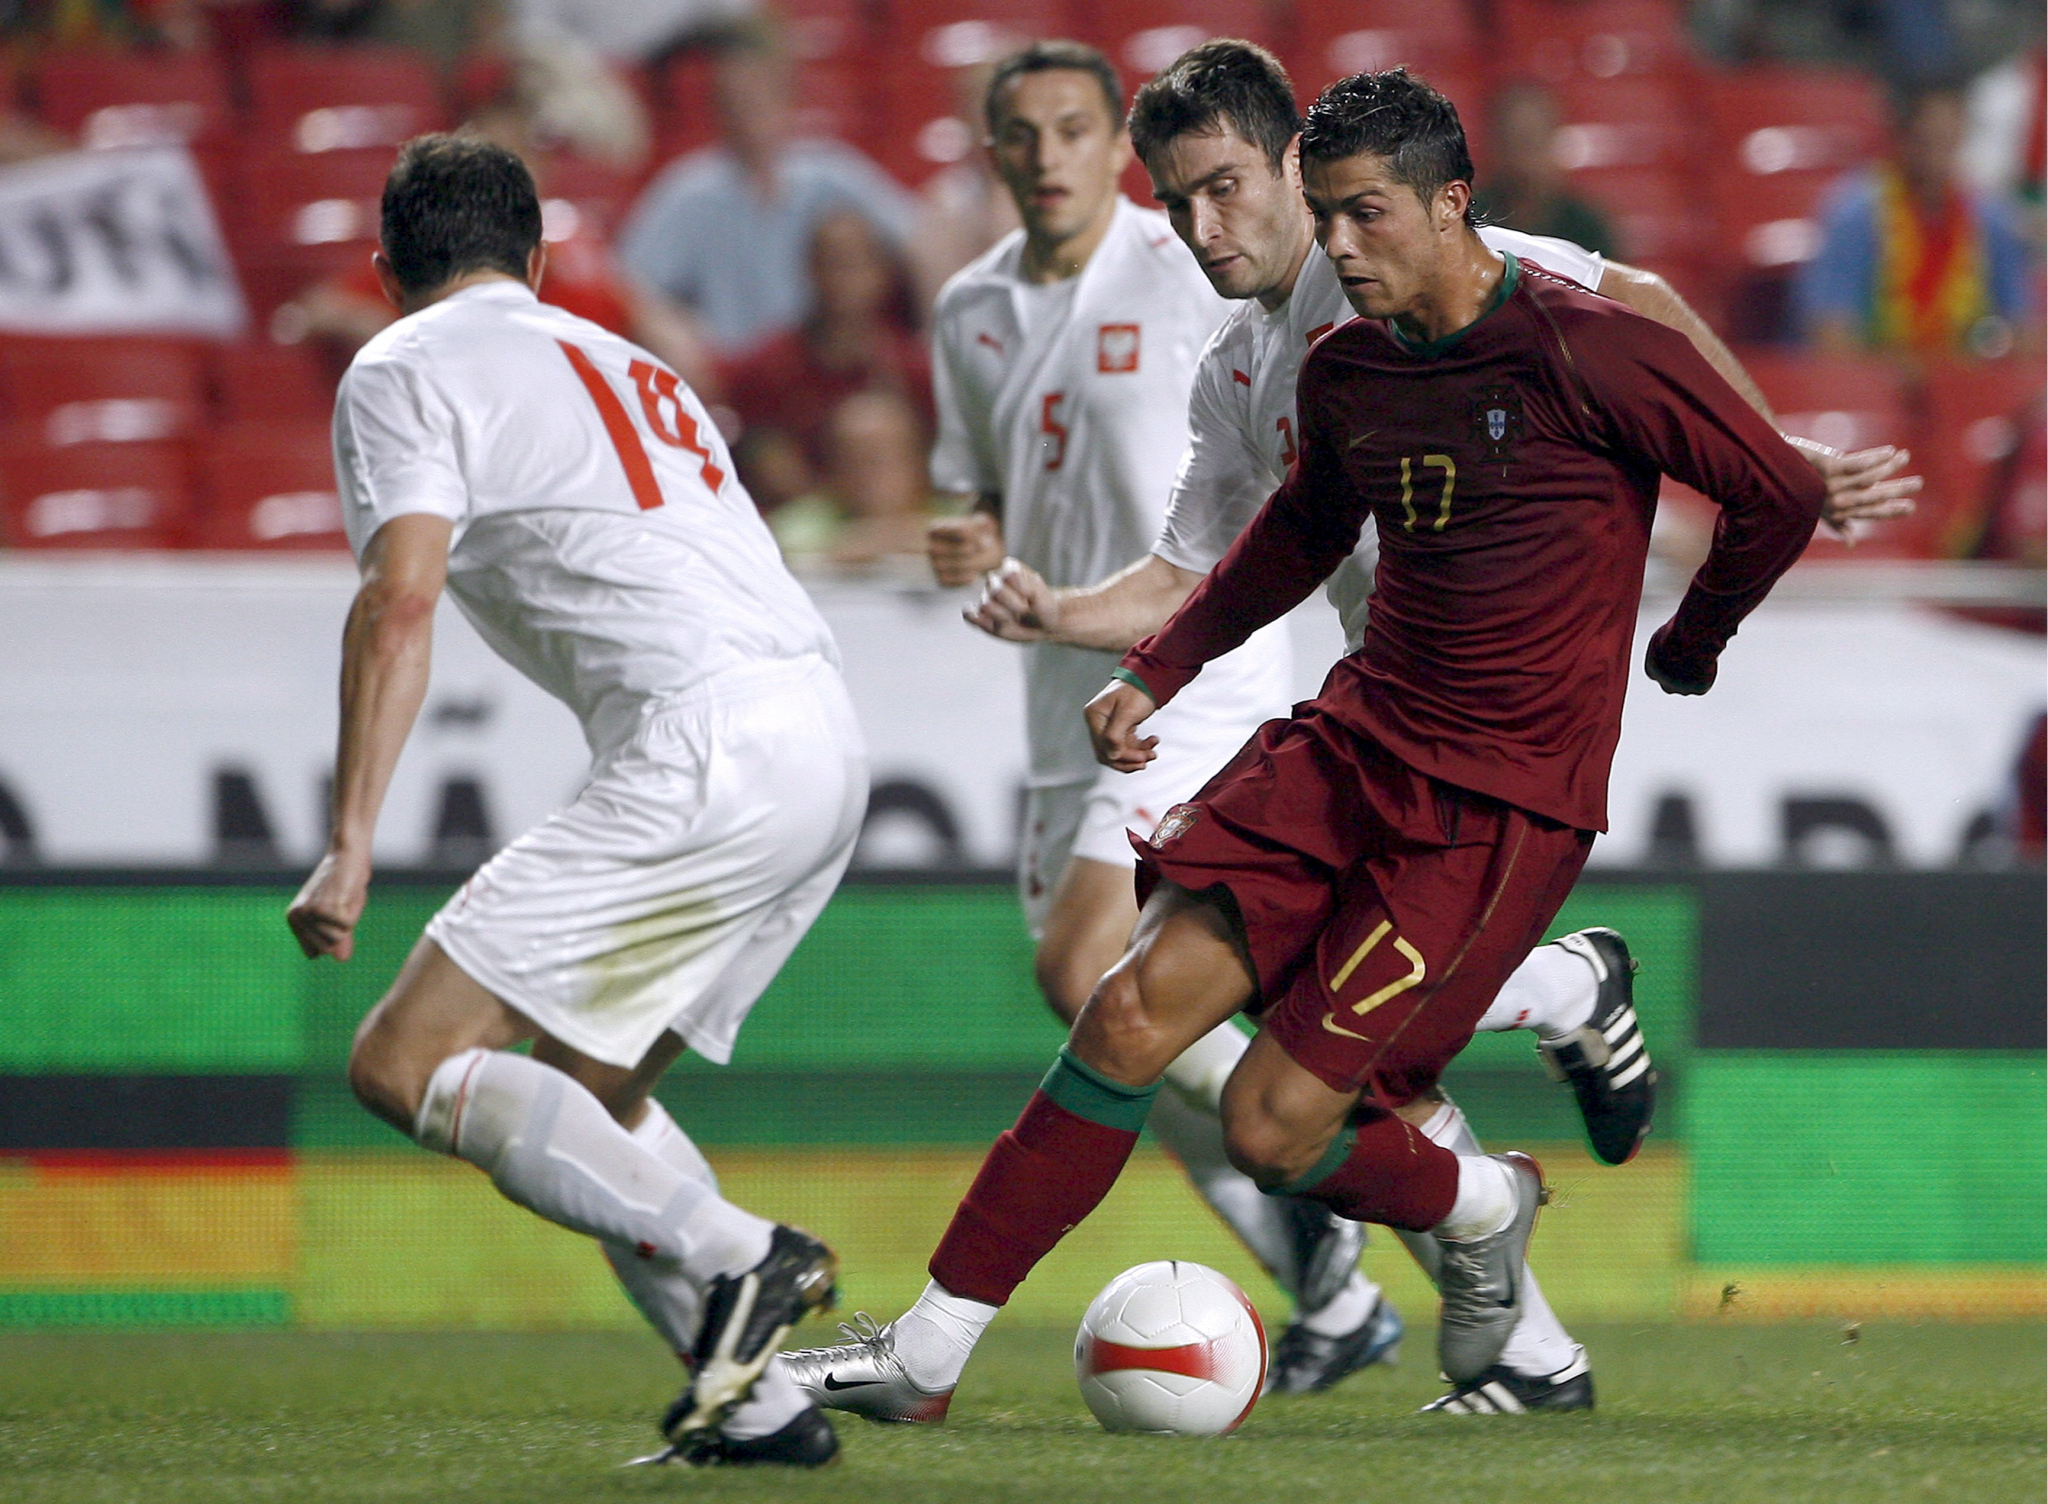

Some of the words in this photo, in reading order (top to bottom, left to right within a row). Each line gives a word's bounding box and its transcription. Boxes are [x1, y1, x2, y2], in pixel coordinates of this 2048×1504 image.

[1042, 392, 1067, 472] 5
[1400, 454, 1456, 533] 17
[1330, 920, 1426, 1016] 17
